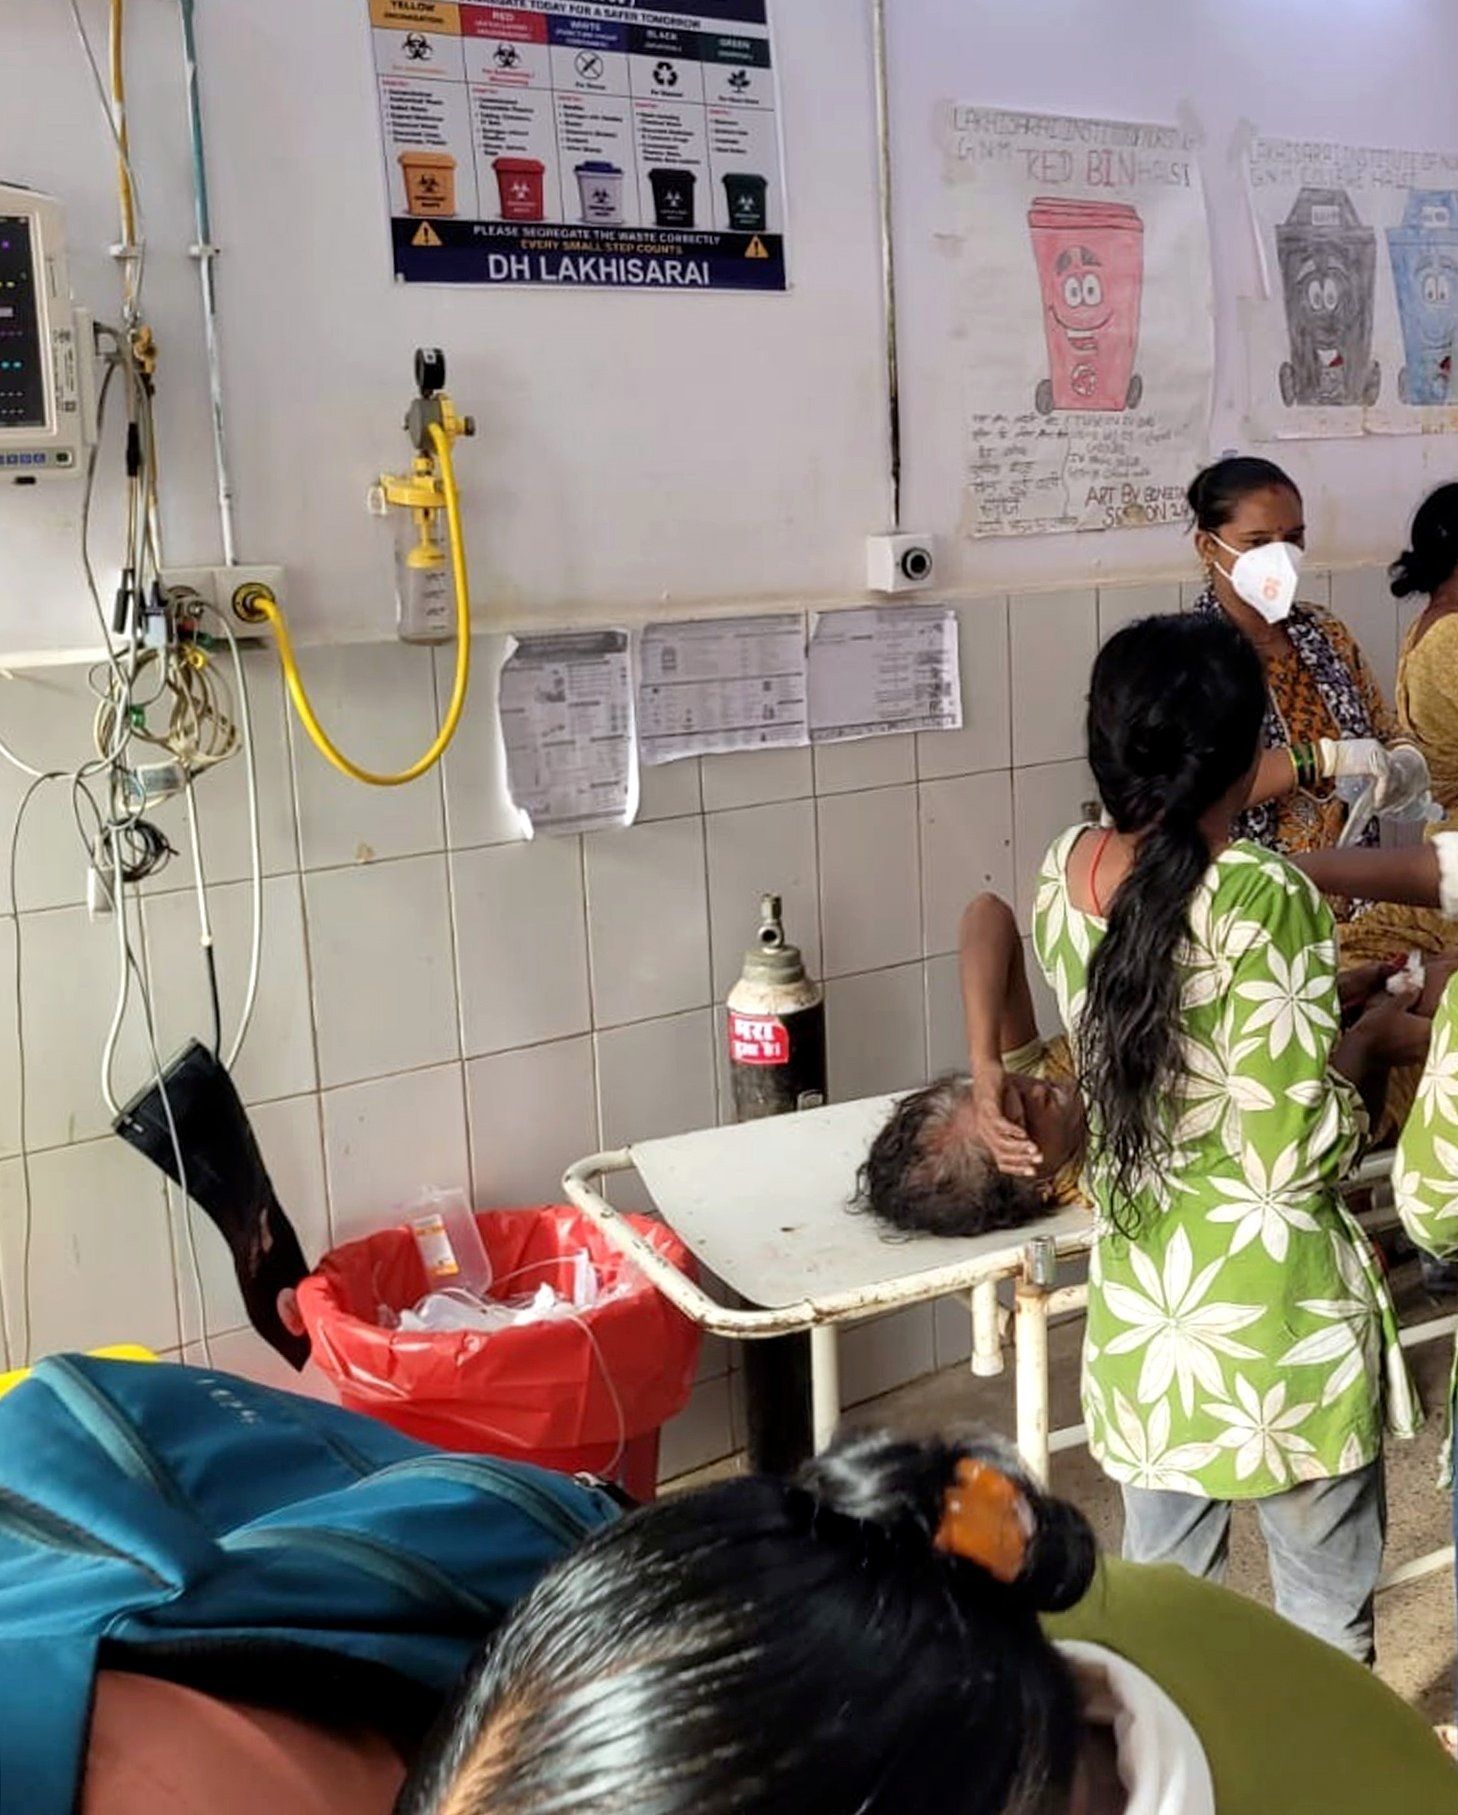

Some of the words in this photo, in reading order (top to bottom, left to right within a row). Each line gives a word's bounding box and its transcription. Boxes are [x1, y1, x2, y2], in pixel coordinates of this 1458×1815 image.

[530, 0, 566, 12] TODAY
[569, 4, 591, 15] FOR
[593, 6, 601, 16] A
[604, 8, 638, 22] SAFER
[641, 12, 700, 29] TOMORROW
[473, 225, 519, 237] PLEASE
[522, 226, 590, 239] SEGREGATE
[593, 229, 617, 241] THE
[620, 230, 656, 242] WASTE
[659, 232, 720, 246] CORRECTLY
[520, 238, 560, 250] EVERY
[562, 240, 602, 252] SMALL
[605, 241, 635, 253] STEP
[636, 243, 684, 256] COUNTS
[488, 253, 531, 280] DH
[538, 256, 711, 285] LAKHISARAI
[1084, 486, 1117, 508] ART
